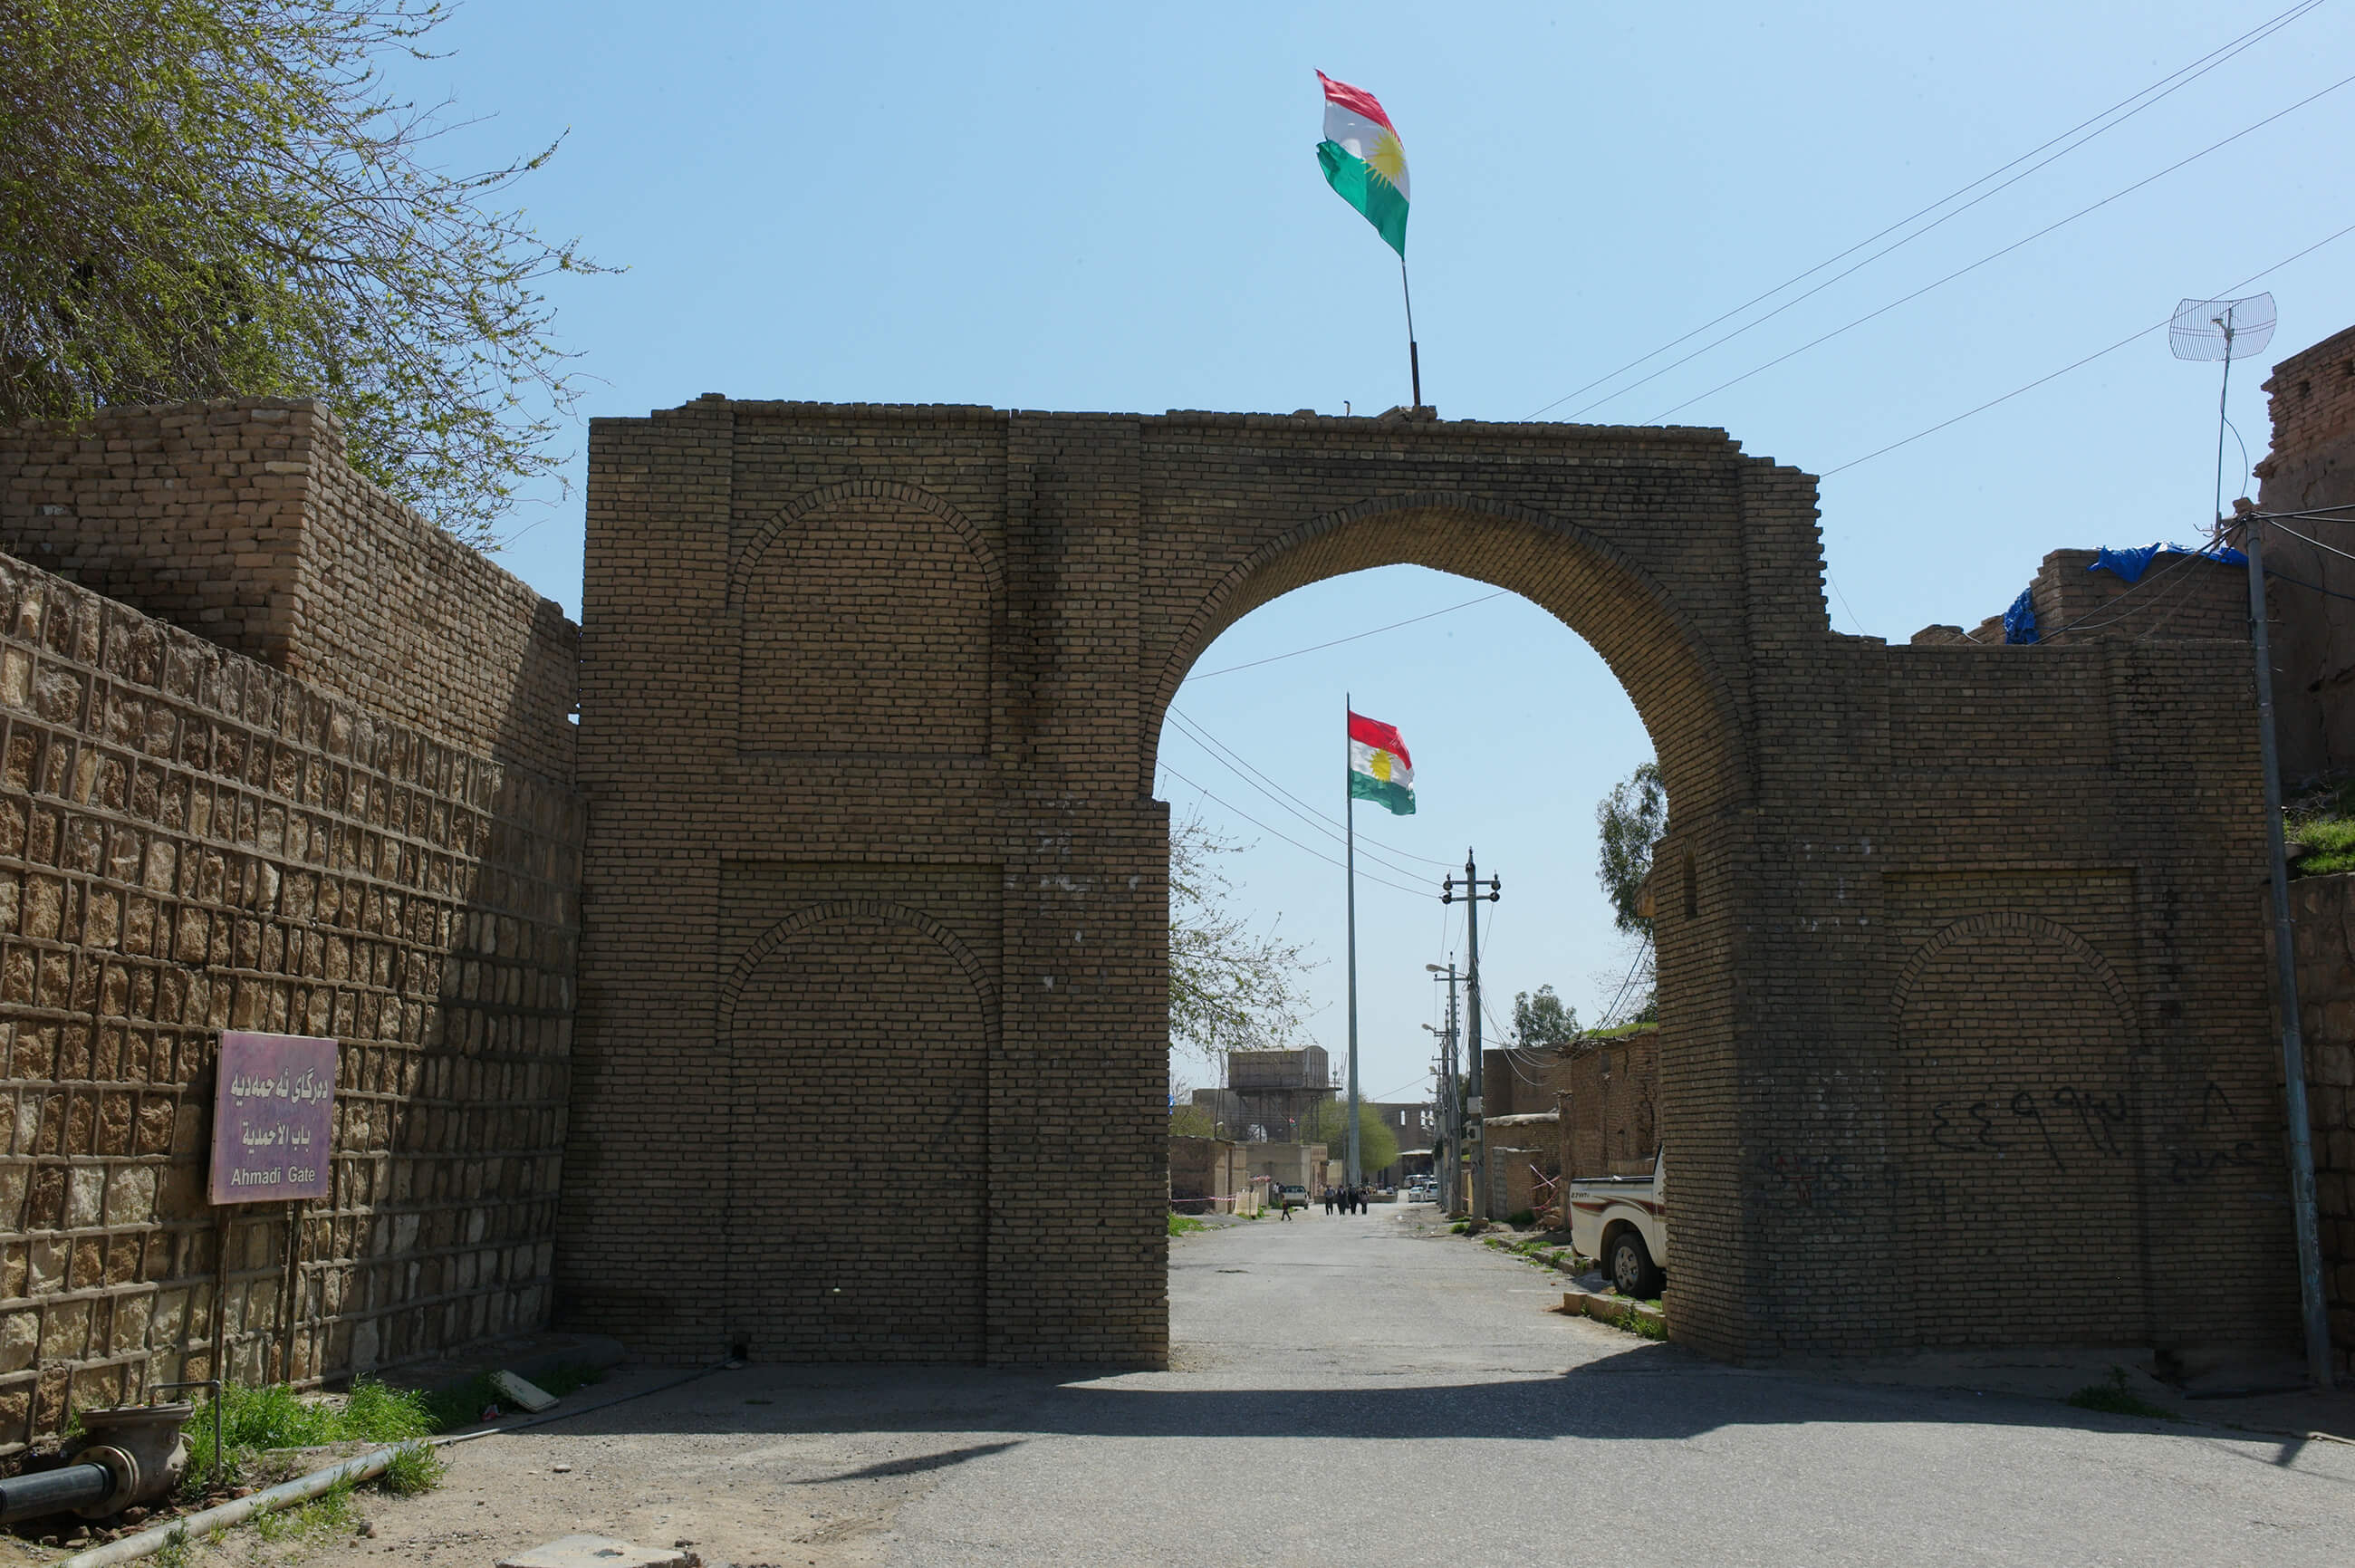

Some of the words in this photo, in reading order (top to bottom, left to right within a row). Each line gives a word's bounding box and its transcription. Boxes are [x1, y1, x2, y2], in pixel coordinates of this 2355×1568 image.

[291, 1124, 311, 1152] باب
[231, 1167, 281, 1186] Ahmadi
[288, 1165, 315, 1183] Gate
